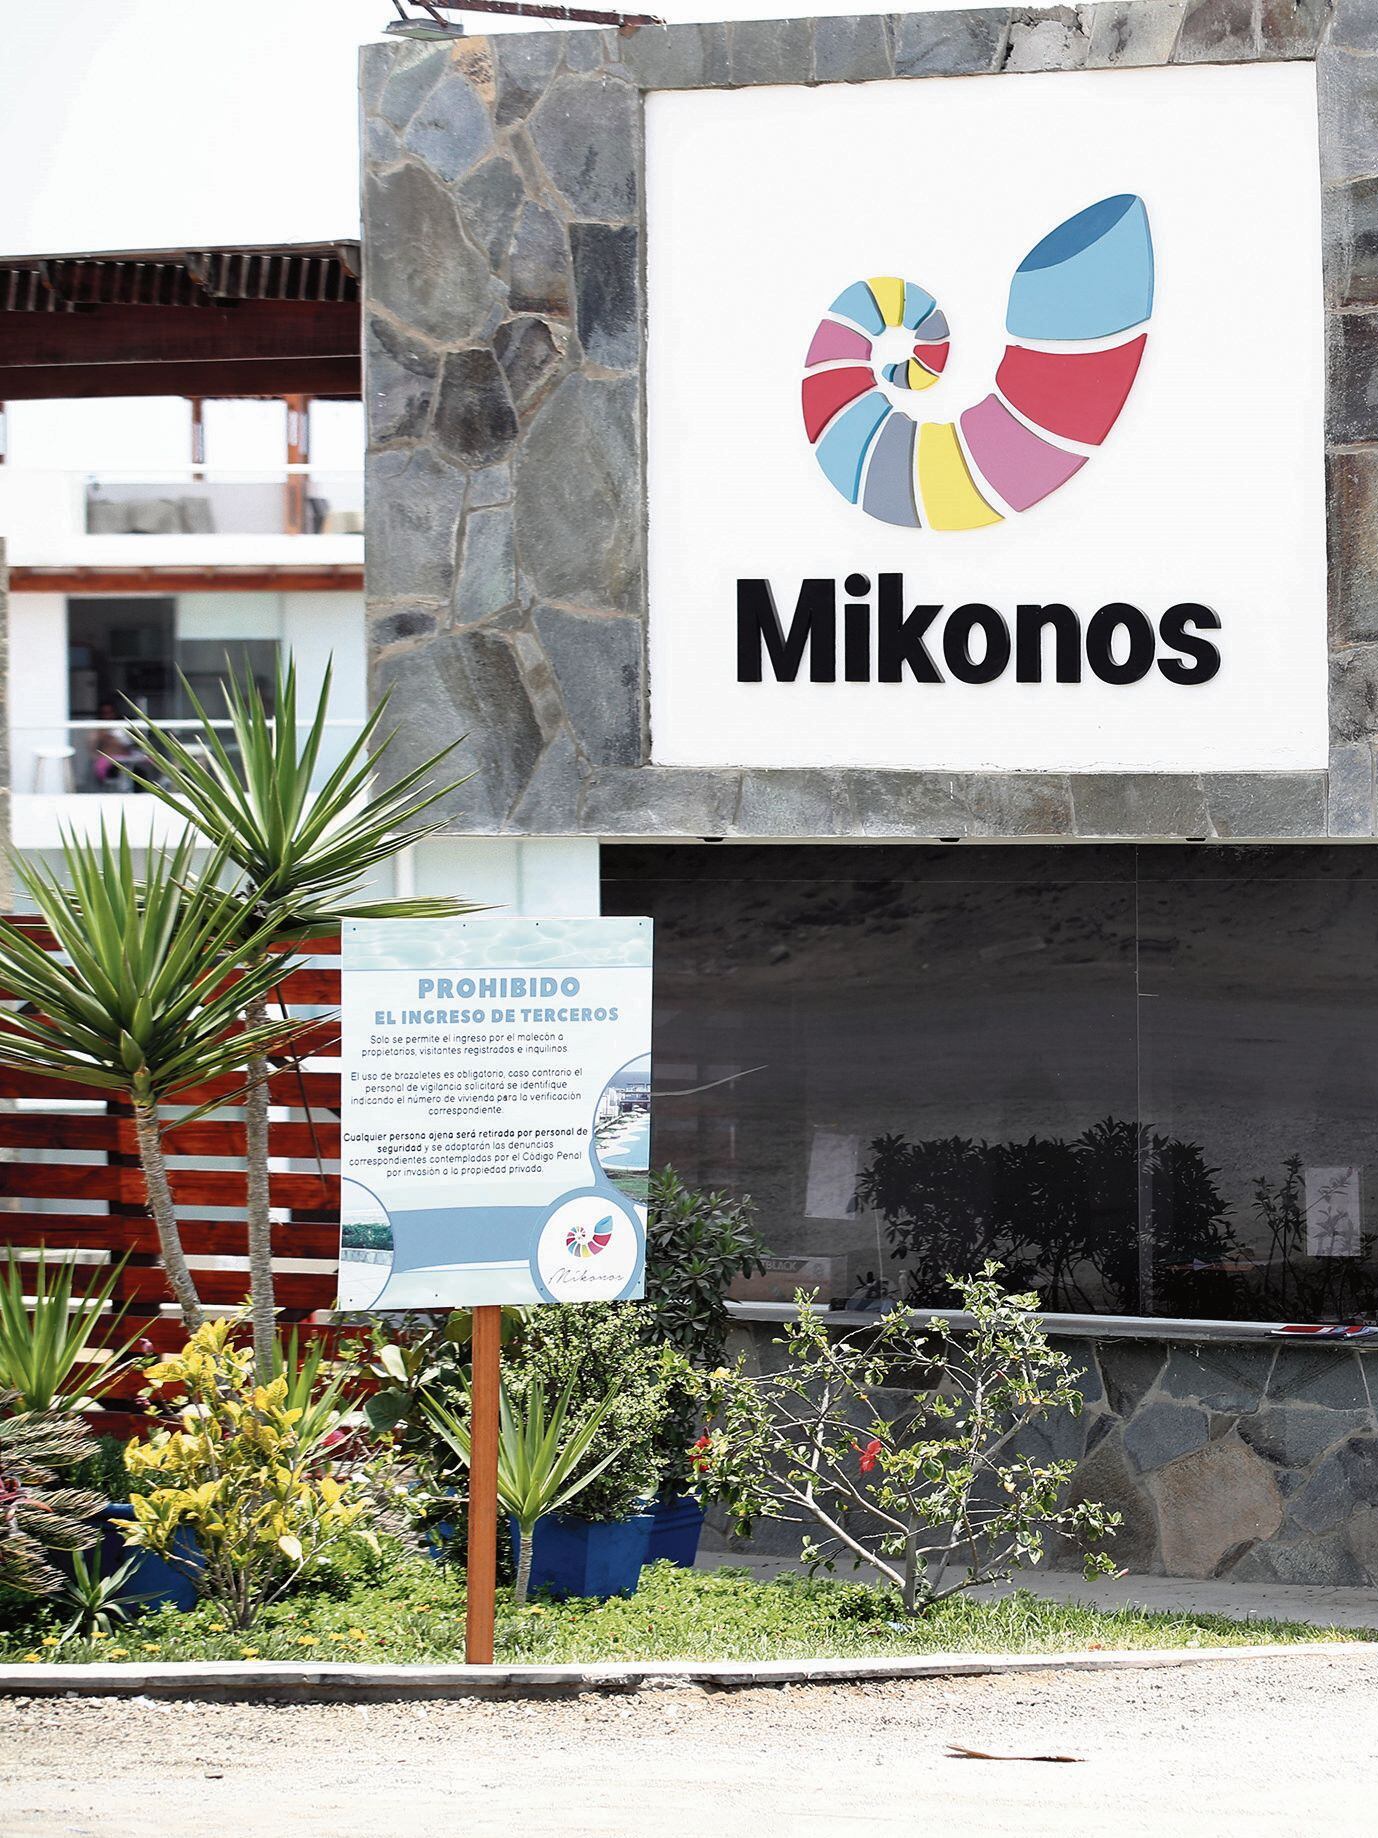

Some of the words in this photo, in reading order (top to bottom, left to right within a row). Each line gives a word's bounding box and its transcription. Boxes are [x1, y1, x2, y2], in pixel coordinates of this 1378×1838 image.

[737, 573, 1222, 686] Mikonos
[418, 976, 580, 999] PROHIBIDO
[375, 1010, 396, 1025] EL
[401, 1009, 485, 1025] INGRESO
[491, 1009, 515, 1023] DE
[520, 1007, 619, 1023] TERCEROS
[370, 1035, 389, 1044] Solo
[405, 1035, 440, 1046] permite
[443, 1035, 451, 1043] el
[453, 1034, 486, 1045] ingreso
[489, 1034, 504, 1043] por
[507, 1033, 515, 1041] el
[419, 1046, 462, 1055] visitantes
[464, 1045, 515, 1056] registrados
[526, 1044, 568, 1054] inquilinos
[351, 1072, 359, 1081] El
[362, 1073, 378, 1081] uso
[380, 1071, 392, 1080] de
[395, 1071, 441, 1080] brazaletes
[444, 1071, 454, 1079] es
[508, 1070, 529, 1078] caso
[532, 1069, 572, 1077] contrario
[574, 1068, 582, 1076] el
[365, 1083, 404, 1093] personal
[407, 1083, 418, 1091] de
[421, 1082, 462, 1093] vigilancia
[520, 1080, 568, 1090] identifique
[351, 1096, 393, 1105] indicando
[397, 1095, 405, 1103] el
[408, 1094, 441, 1103] número
[458, 1094, 495, 1102] vivienda
[497, 1094, 517, 1103] para
[519, 1093, 527, 1101] la
[343, 1133, 387, 1142] Cualquier
[390, 1132, 426, 1141] persona
[429, 1131, 453, 1141] ajena
[456, 1129, 476, 1139] será
[479, 1129, 514, 1138] retirada
[517, 1130, 532, 1138] por
[535, 1128, 574, 1138] personal
[577, 1127, 588, 1136] de
[377, 1143, 422, 1154] seguridad
[493, 1141, 506, 1150] las
[508, 1140, 554, 1149] denuncias
[349, 1157, 427, 1166] correspondientes
[430, 1154, 492, 1165] contempladas
[494, 1154, 509, 1163] por
[512, 1153, 520, 1161] el
[557, 1151, 582, 1160] Penal
[386, 1169, 402, 1178] por
[451, 1167, 458, 1175] la
[461, 1166, 506, 1176] propiedad
[548, 1267, 625, 1285] Mikonos
